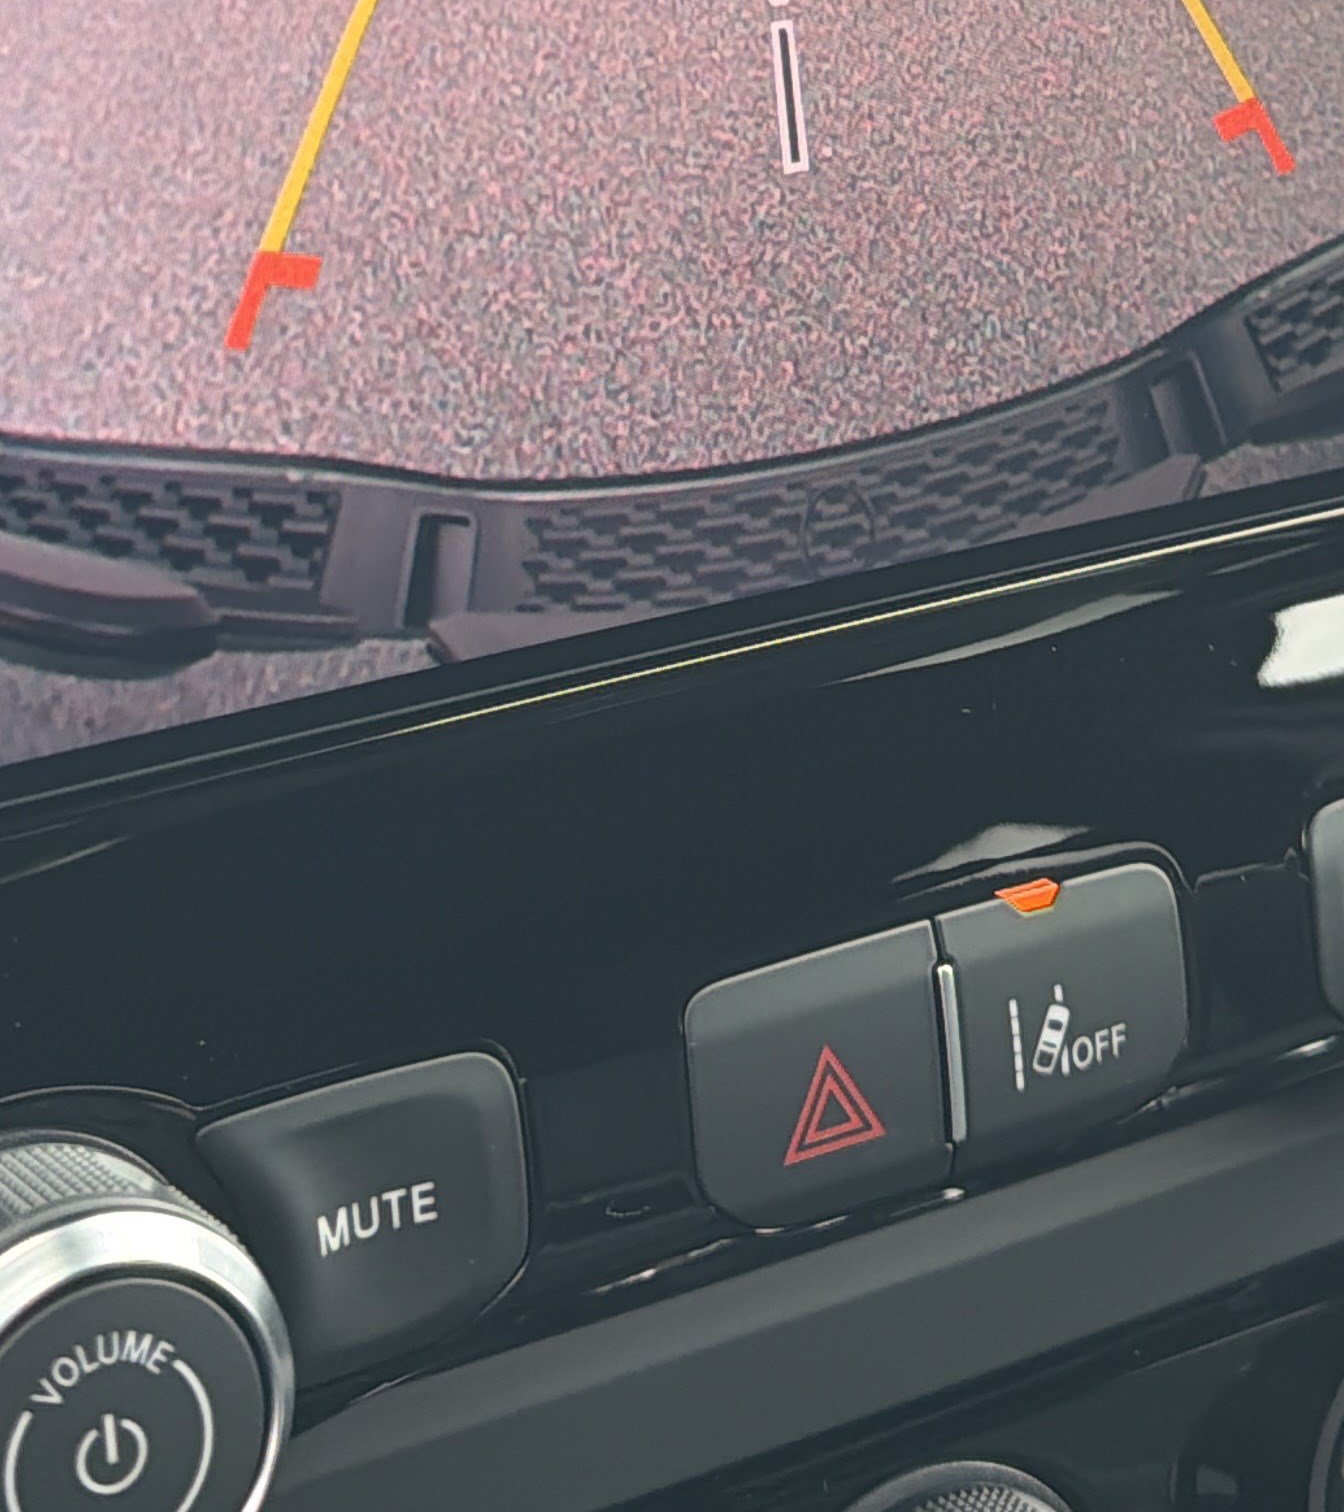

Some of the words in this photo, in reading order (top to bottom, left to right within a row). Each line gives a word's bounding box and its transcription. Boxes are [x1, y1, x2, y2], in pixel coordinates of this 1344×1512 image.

[1072, 1022, 1127, 1069] OFF
[316, 1181, 438, 1257] MUTE
[29, 1330, 175, 1406] VOLUME
